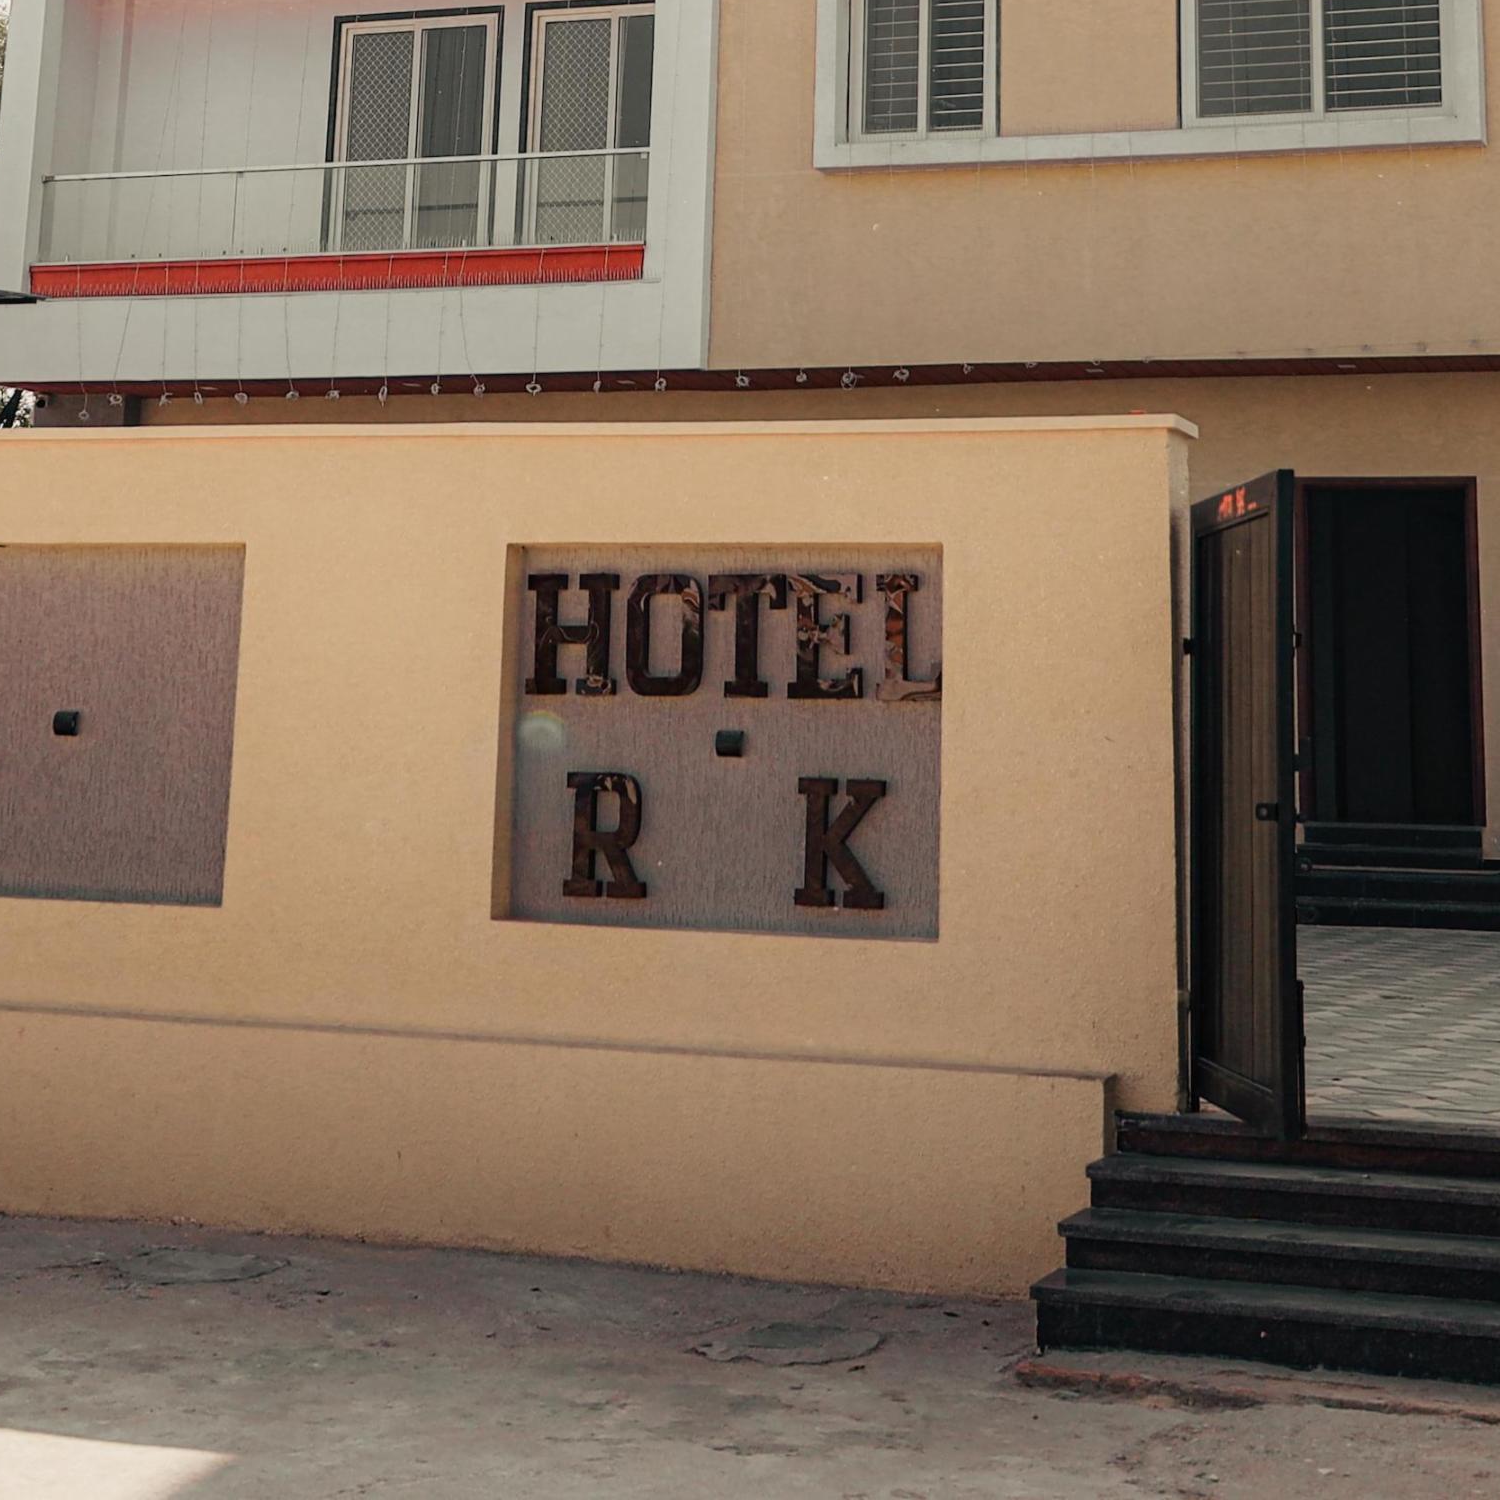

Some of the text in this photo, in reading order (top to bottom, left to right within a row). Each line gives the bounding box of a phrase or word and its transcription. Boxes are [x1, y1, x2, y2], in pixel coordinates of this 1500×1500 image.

[525, 573, 942, 701] HOTEL
[563, 771, 887, 910] R K
